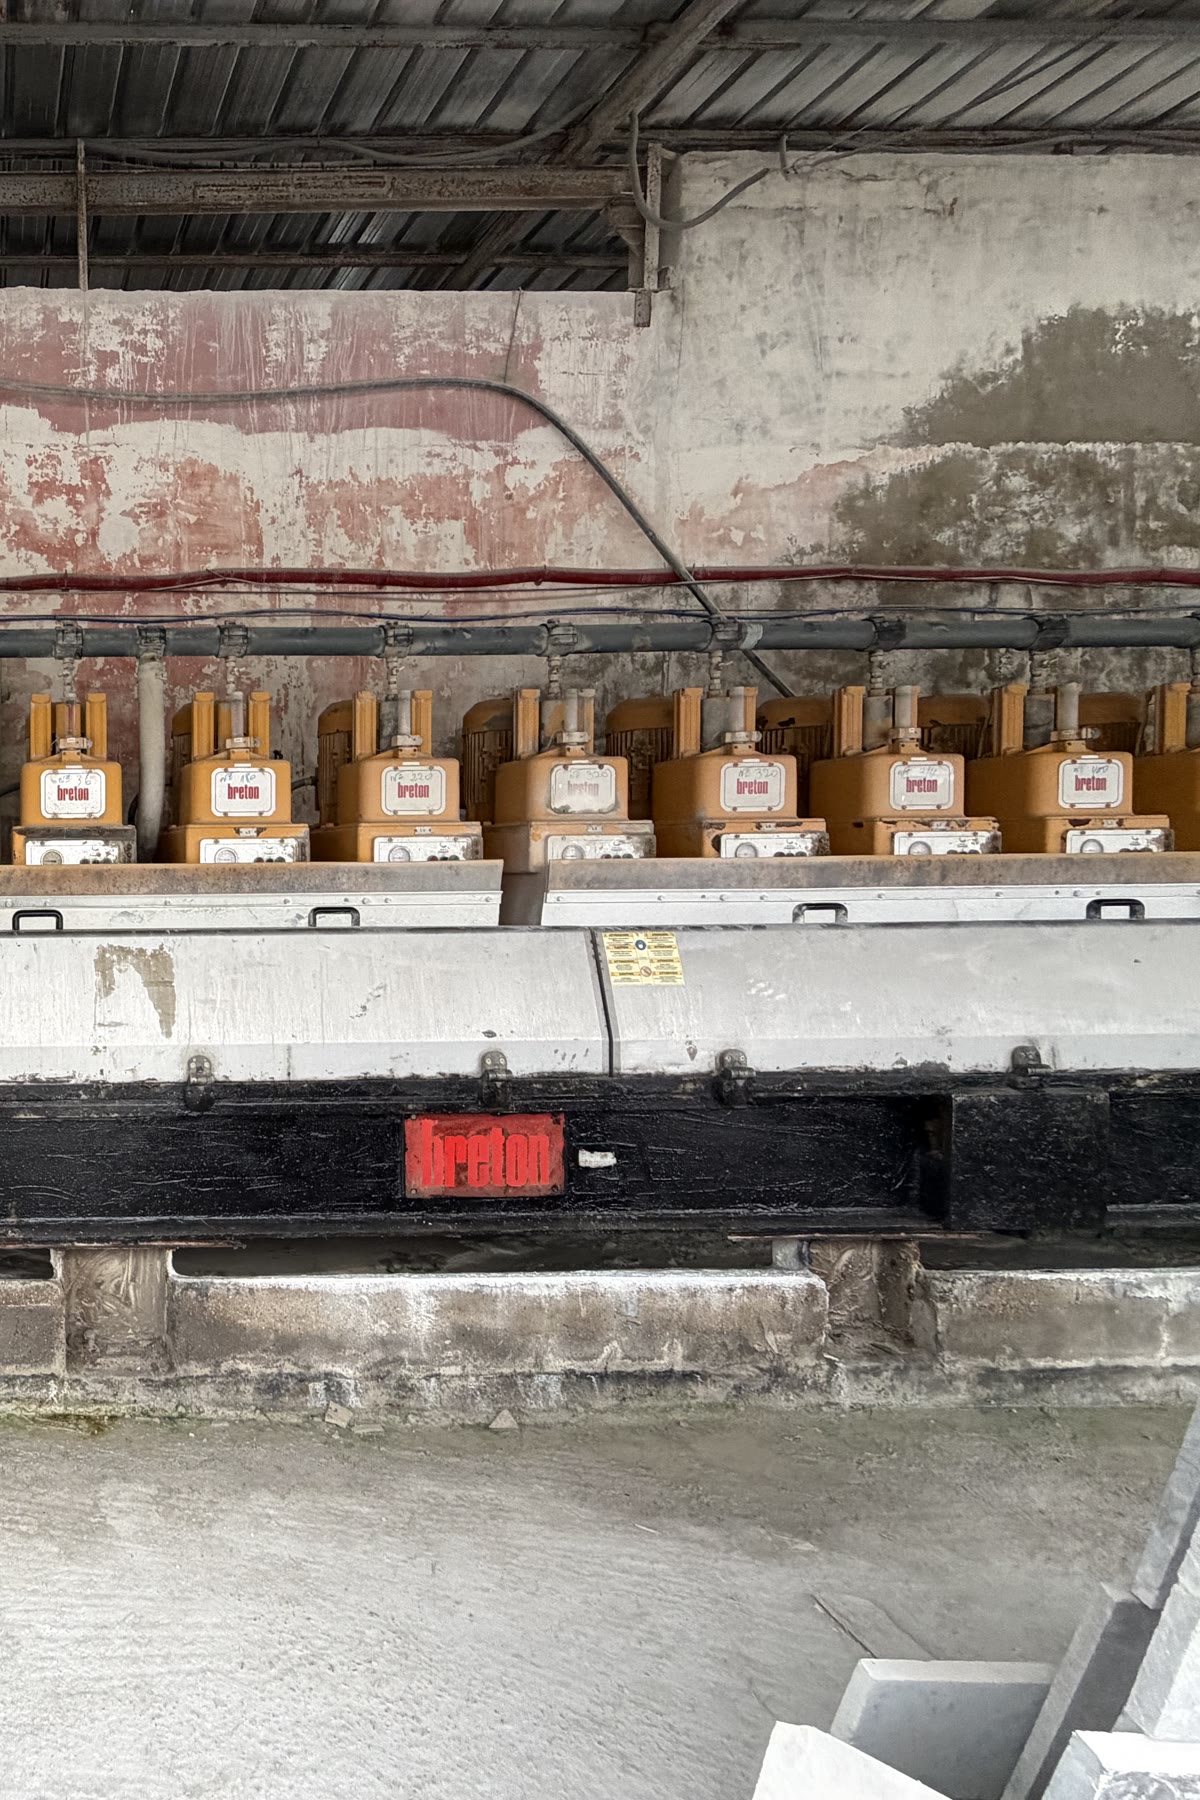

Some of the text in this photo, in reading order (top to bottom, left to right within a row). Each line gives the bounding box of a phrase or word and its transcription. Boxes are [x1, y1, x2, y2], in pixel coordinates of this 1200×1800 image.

[398, 782, 429, 798] breton
[737, 778, 768, 794] breton
[906, 777, 938, 792] breton
[1075, 775, 1107, 791] breton
[57, 785, 89, 801] breton
[227, 783, 259, 800] breton
[421, 1119, 550, 1188] breton
